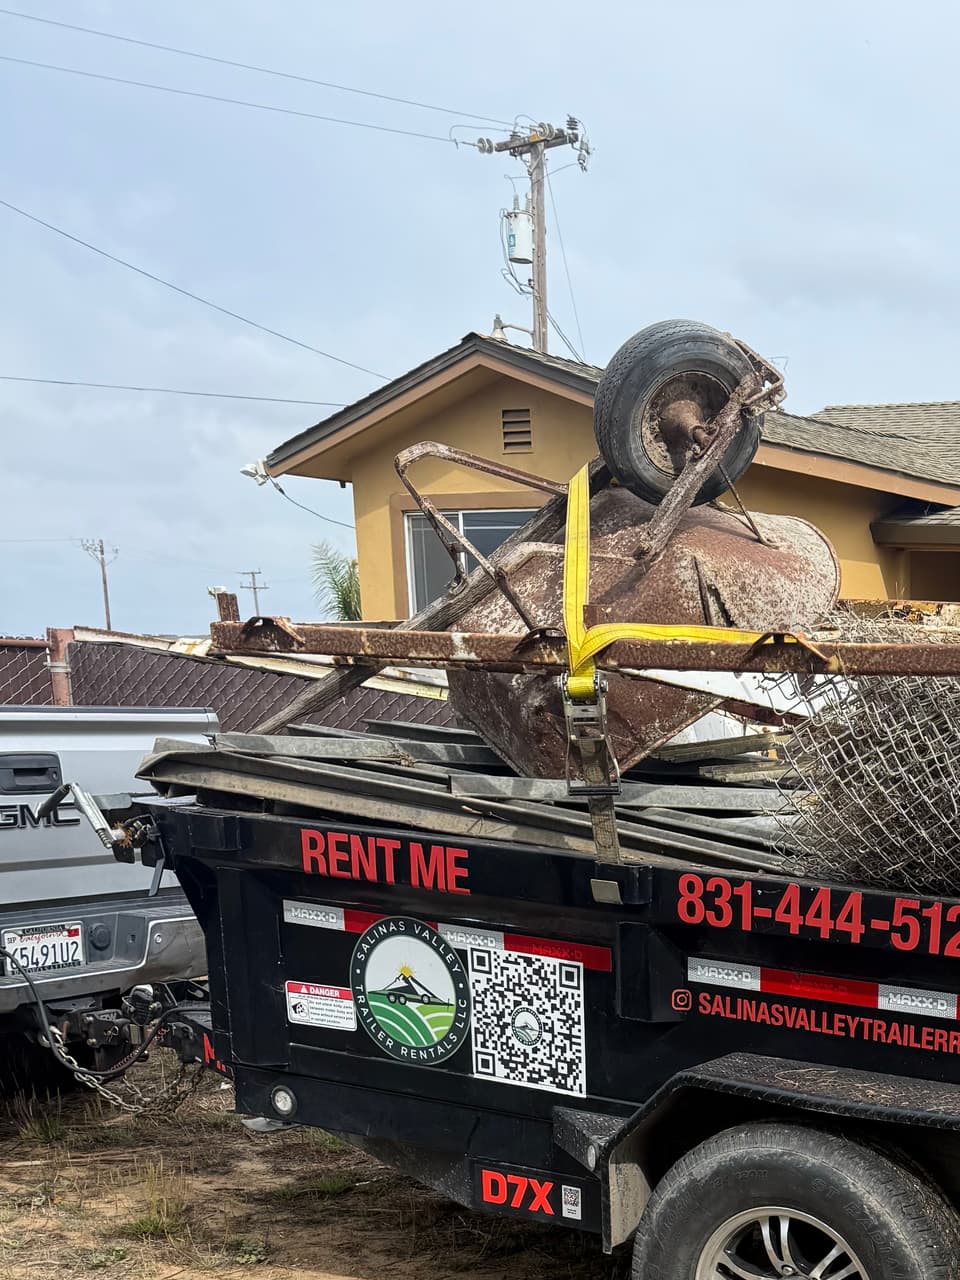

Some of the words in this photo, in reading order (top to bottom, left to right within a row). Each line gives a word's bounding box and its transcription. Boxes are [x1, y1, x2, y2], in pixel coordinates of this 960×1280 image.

[0, 802, 81, 829] GMC
[300, 828, 401, 886] RENT
[409, 842, 471, 896] ME
[357, 920, 406, 961] SALINAS
[413, 923, 462, 973] VALLEY
[309, 986, 340, 998] DANGER
[354, 984, 394, 1049] TRAILER
[400, 1032, 458, 1060] RENTALS
[455, 998, 467, 1029] LLC
[481, 1168, 555, 1216] D7X
